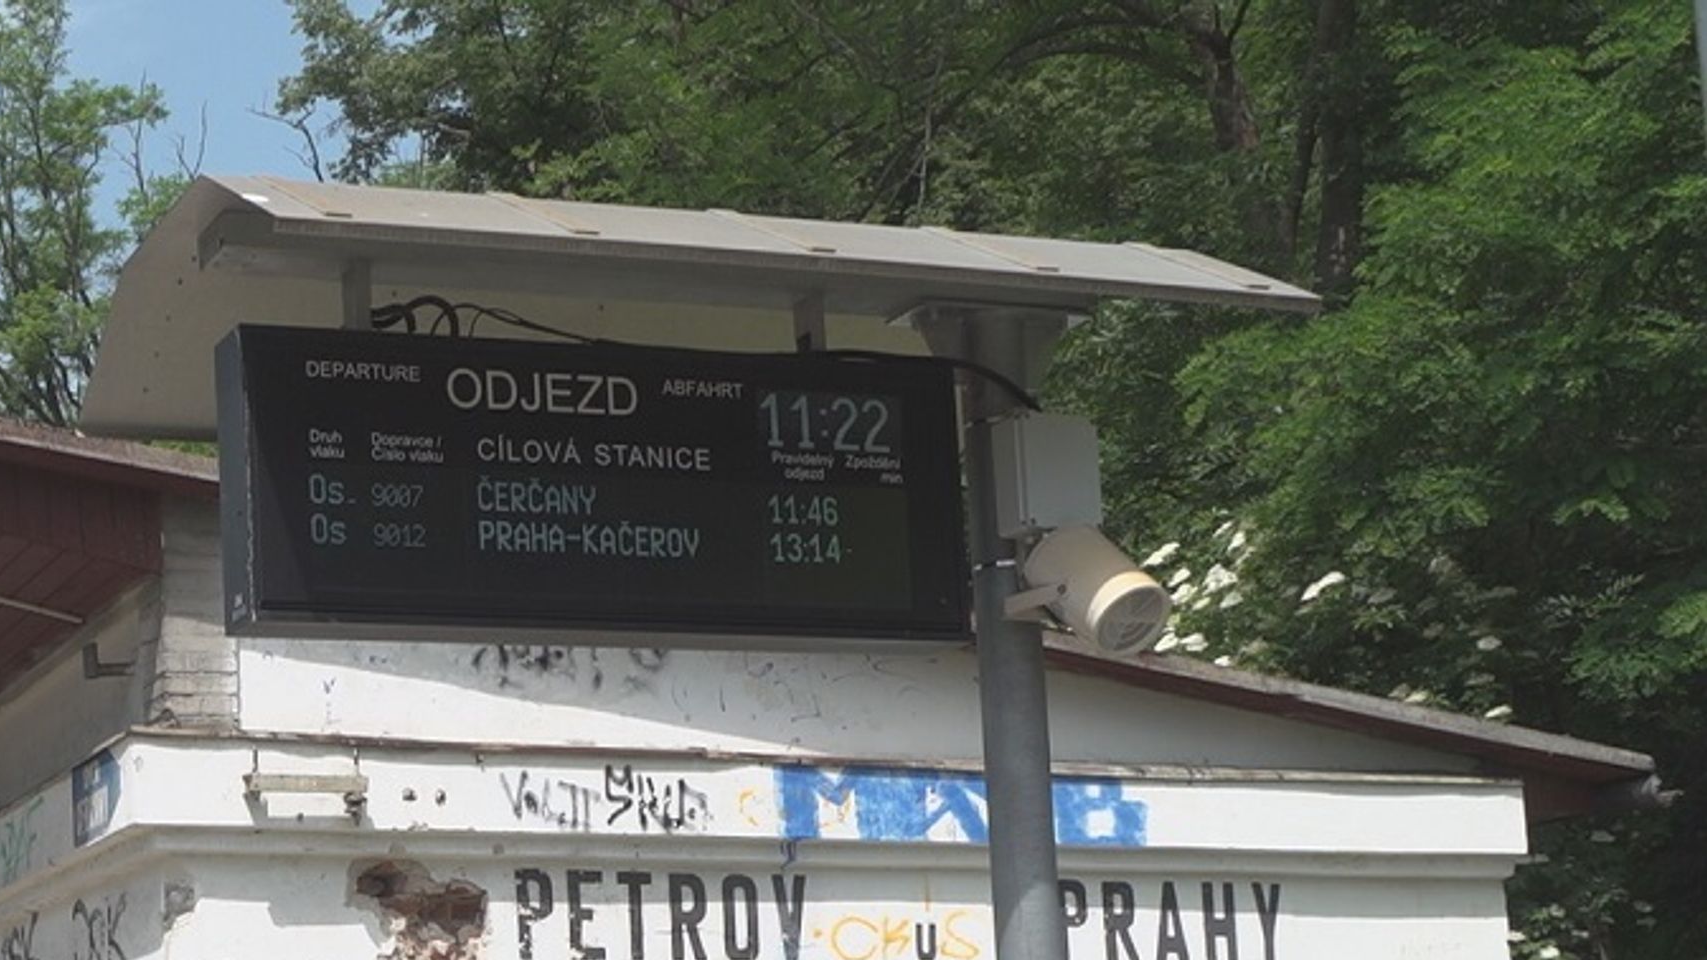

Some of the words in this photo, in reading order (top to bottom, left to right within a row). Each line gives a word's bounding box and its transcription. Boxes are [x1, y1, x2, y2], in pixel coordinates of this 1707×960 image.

[305, 360, 421, 382] DEPARTURE
[447, 368, 637, 415] ODJEZD
[662, 379, 743, 398] ABFAHRT
[309, 429, 343, 444] Druh
[760, 393, 891, 453] 11:22
[309, 445, 345, 459] vlaku
[409, 448, 444, 463] vlaku
[477, 434, 581, 464] CÍLOVÁ
[594, 443, 711, 471] STANICE
[371, 482, 424, 508] 9007
[477, 475, 596, 515] ČERČANY
[768, 494, 838, 526] 11:46
[373, 522, 426, 548] 9012
[478, 520, 699, 558] PRAHA-KAČEROV
[770, 532, 841, 564] 13:14
